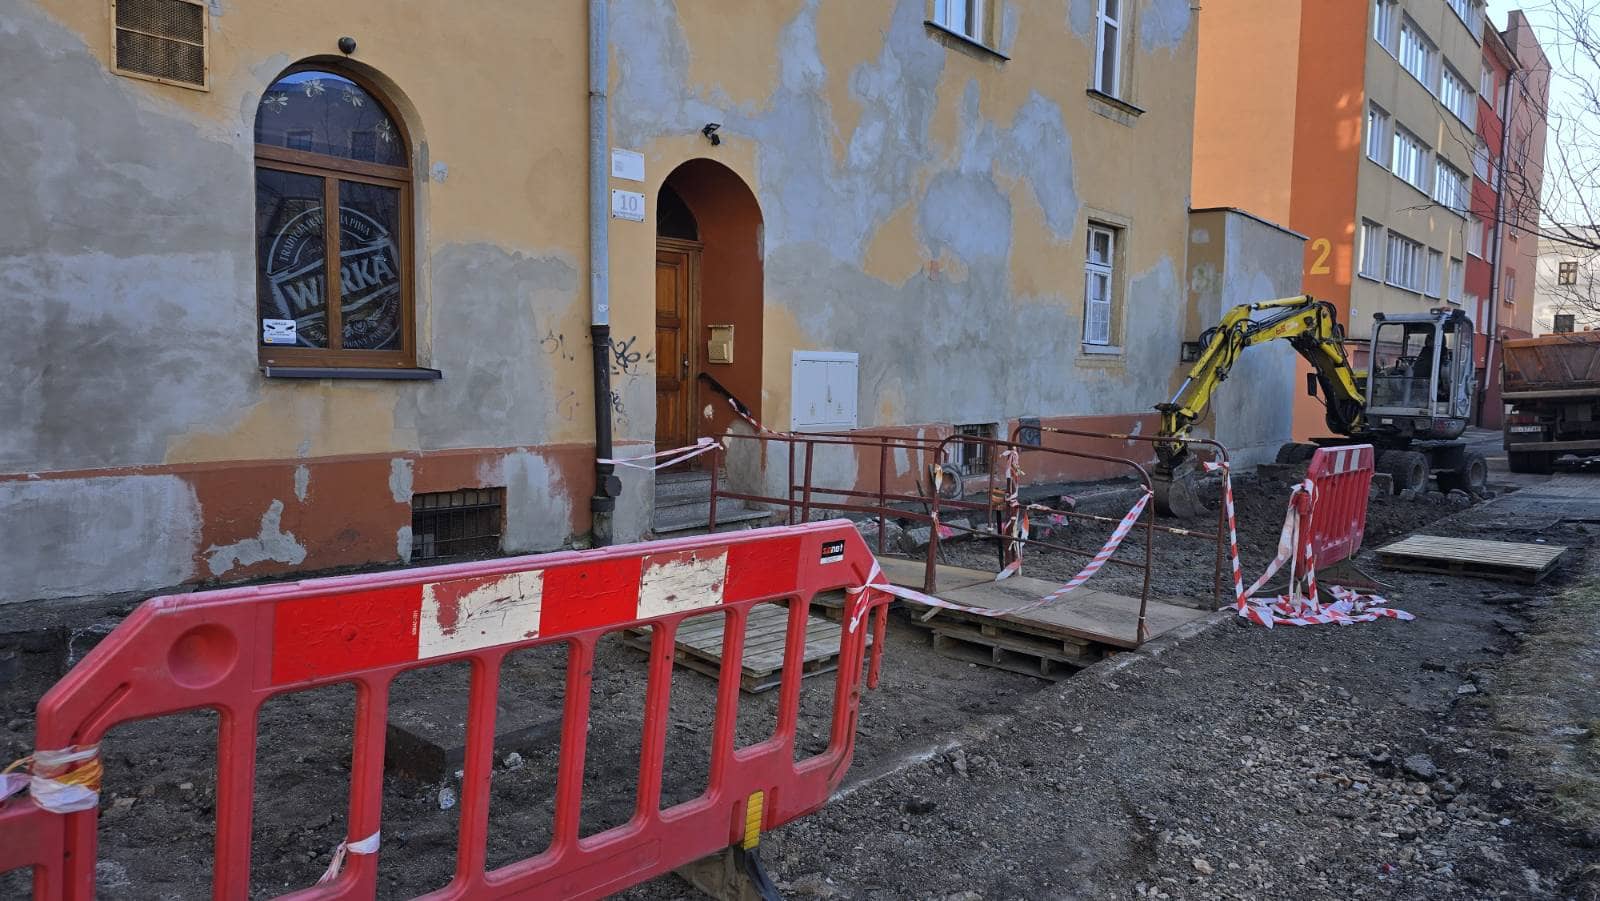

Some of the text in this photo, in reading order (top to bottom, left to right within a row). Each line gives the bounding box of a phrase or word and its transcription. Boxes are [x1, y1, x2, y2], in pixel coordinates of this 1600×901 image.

[621, 195, 638, 212] 10
[1310, 238, 1331, 275] 2
[284, 254, 396, 312] WRKA
